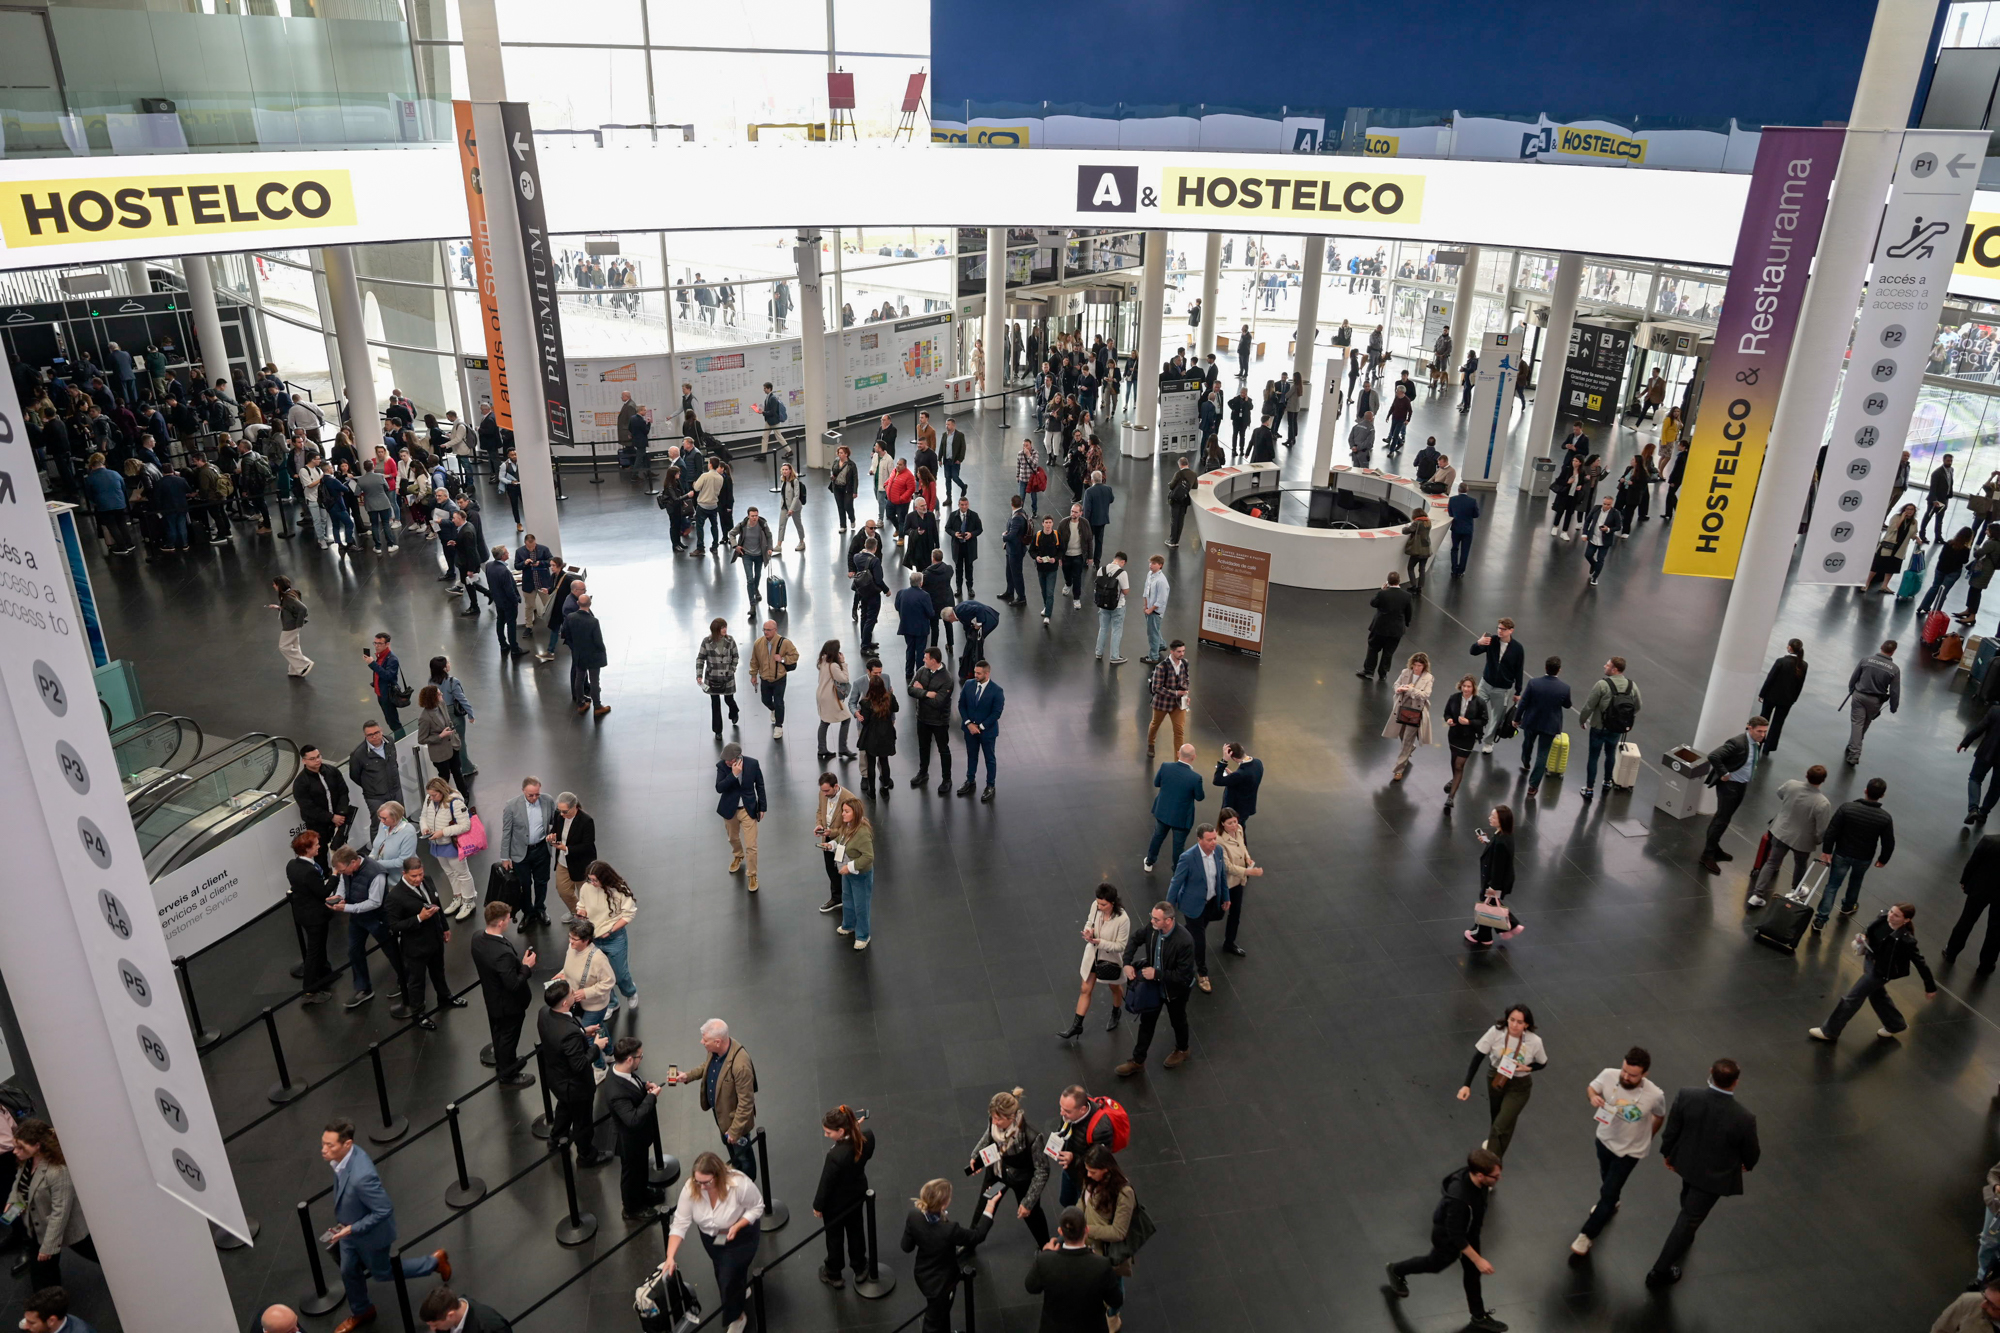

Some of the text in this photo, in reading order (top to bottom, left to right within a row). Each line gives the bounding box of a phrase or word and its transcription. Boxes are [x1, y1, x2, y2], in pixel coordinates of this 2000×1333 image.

[1562, 130, 1642, 159] HOSTELCO
[1915, 160, 1932, 171] P1
[522, 178, 533, 194] P1
[1092, 172, 1405, 215] A & HOSTELCO
[20, 180, 332, 236] HOSTELCO
[1879, 273, 1926, 285] accés a
[1872, 300, 1928, 310] access to
[1875, 288, 1928, 298] acceso a
[528, 225, 560, 386] PREMIUM
[1884, 330, 1902, 341] P2
[1695, 157, 1813, 553] HOSTELCO & Restaurama
[1876, 365, 1893, 376] P3
[1867, 399, 1884, 409] P4
[1858, 437, 1875, 446] 4-6
[1864, 428, 1873, 437] H
[1850, 465, 1867, 475] P5
[1842, 496, 1858, 506] P6
[1834, 527, 1851, 537] P7
[25, 550, 38, 570] a
[1825, 558, 1844, 567] CC7
[43, 584, 57, 603] a
[48, 611, 69, 635] to
[1867, 658, 1893, 670] SECURITAS
[38, 675, 63, 705] P2
[60, 753, 85, 783] P3
[82, 829, 106, 858] P4
[103, 893, 118, 917] H
[158, 869, 228, 917] erveis al client
[162, 877, 239, 929] ervicios al cliente
[107, 912, 129, 937] 4-6
[164, 891, 238, 941] ustomer Service
[122, 969, 146, 997] P5
[142, 1034, 165, 1062] P6
[159, 1097, 180, 1123] P7
[175, 1158, 201, 1182] CC7
